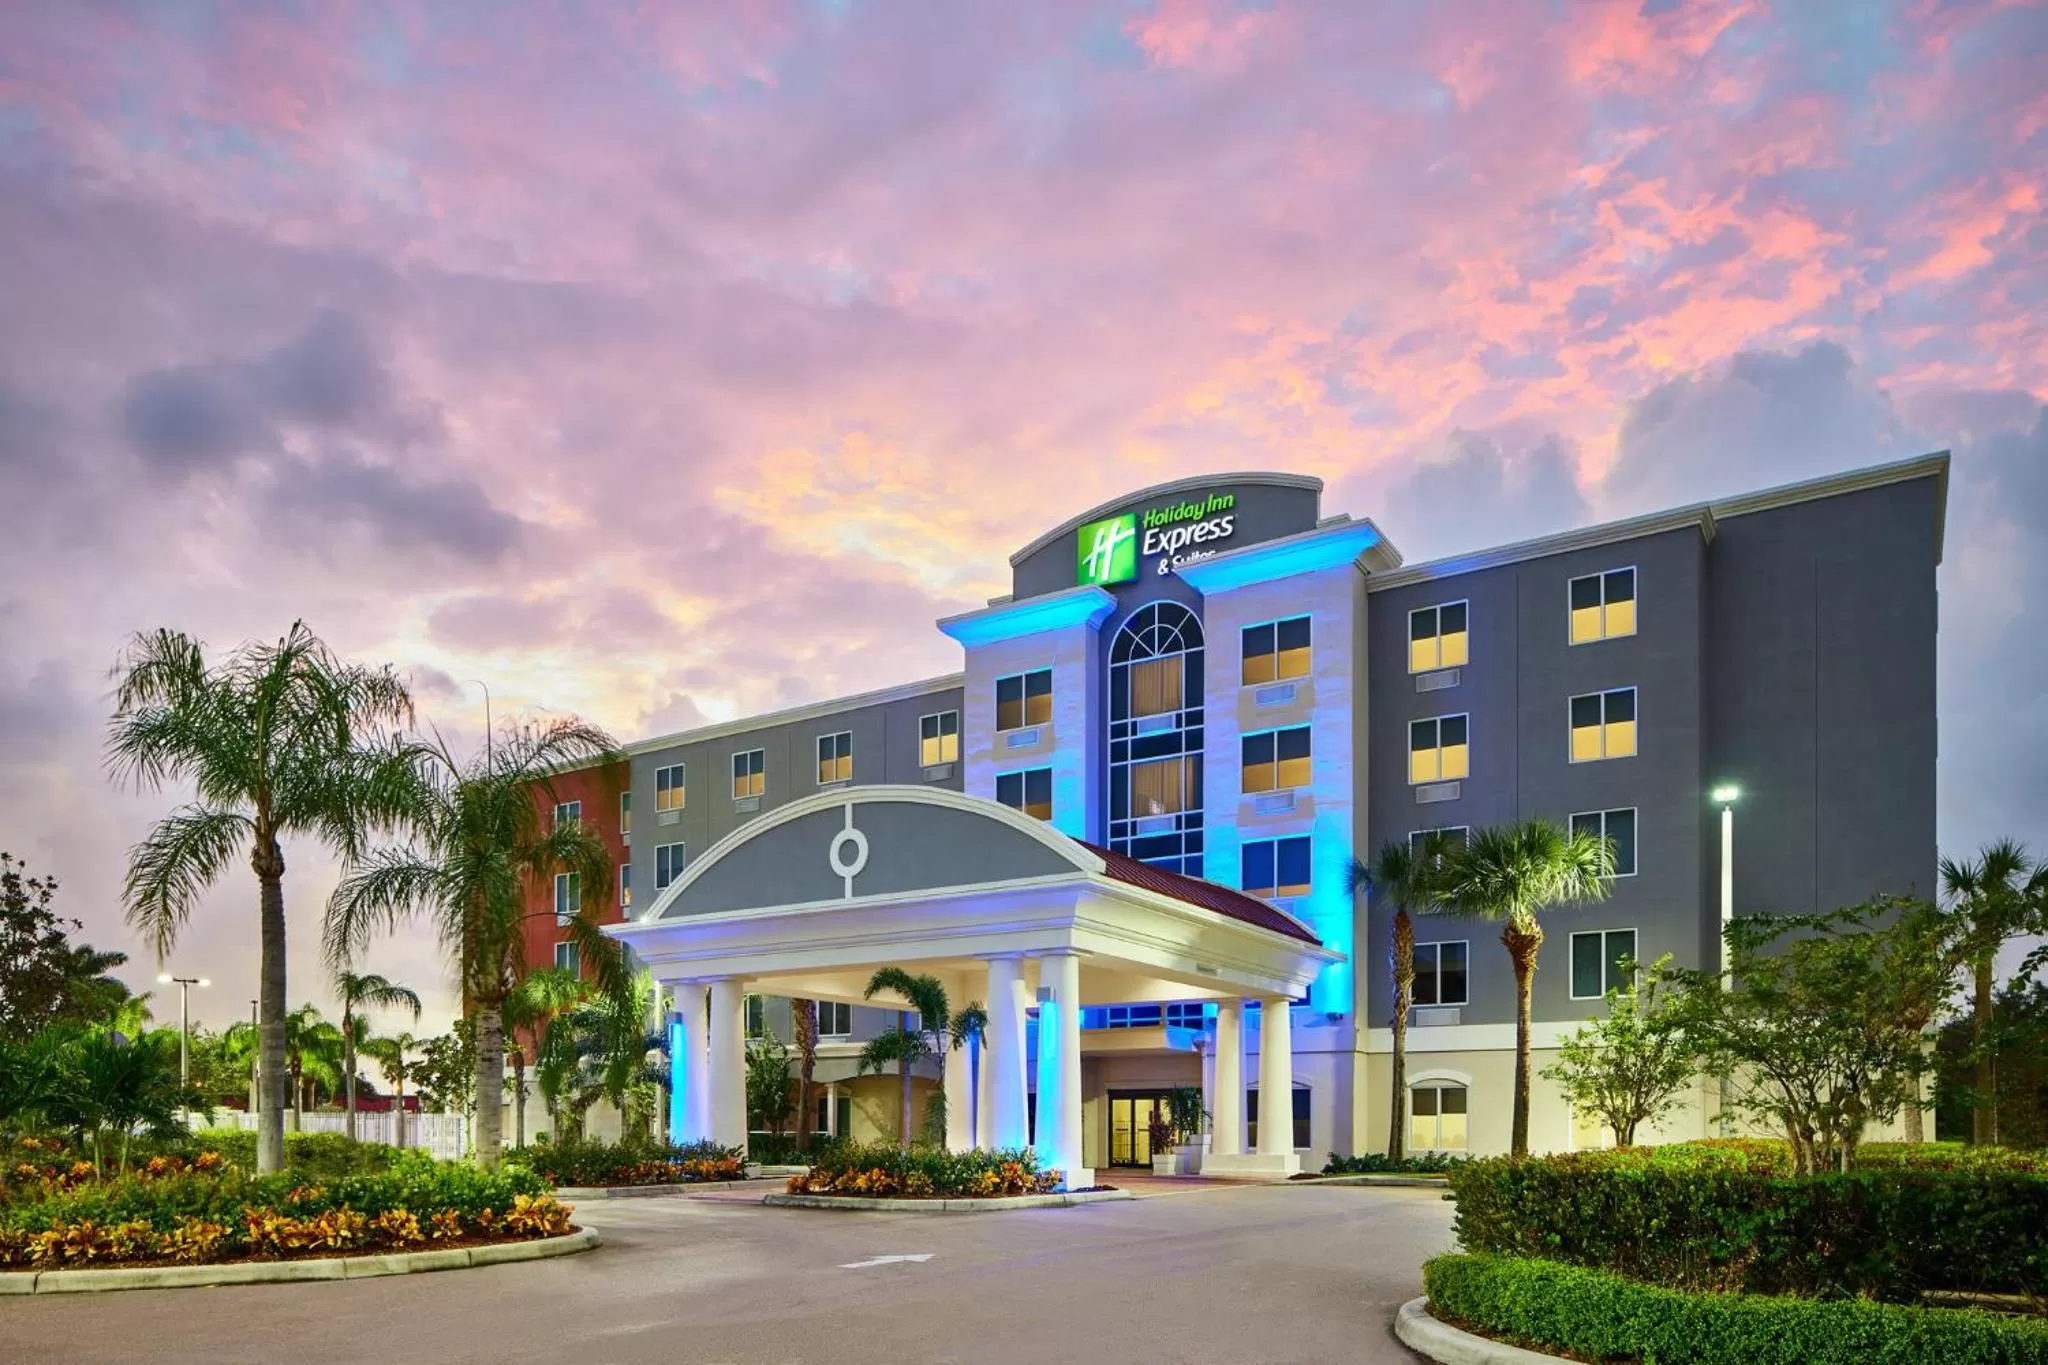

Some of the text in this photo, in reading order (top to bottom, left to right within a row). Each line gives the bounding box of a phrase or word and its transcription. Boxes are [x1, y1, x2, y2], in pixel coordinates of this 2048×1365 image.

[1143, 493, 1234, 529] Holiday Inn
[1142, 515, 1234, 556] Express
[1157, 558, 1170, 576] &
